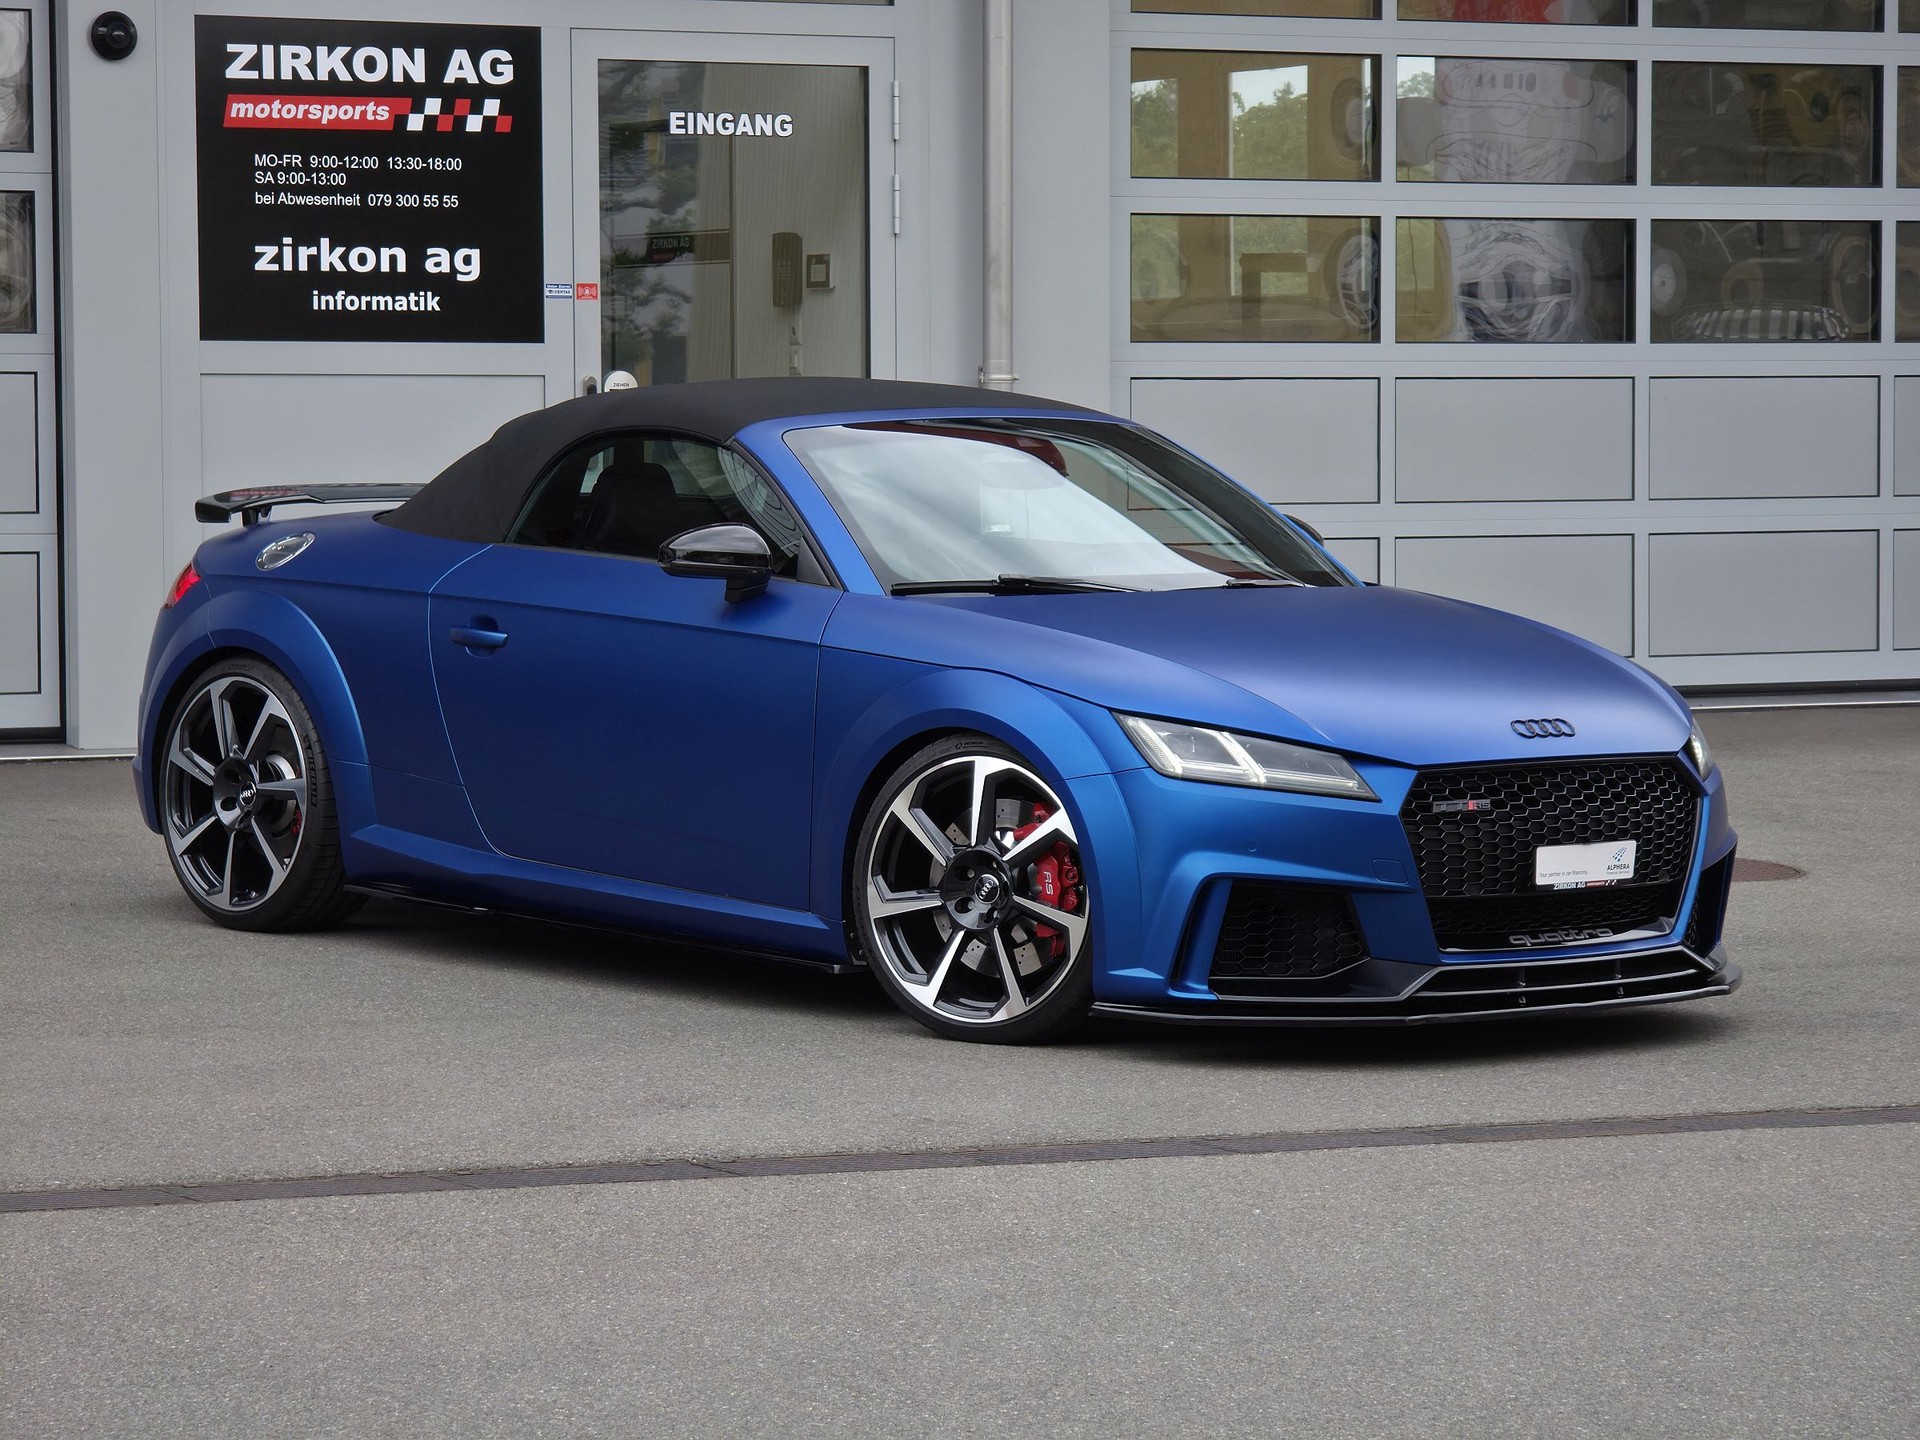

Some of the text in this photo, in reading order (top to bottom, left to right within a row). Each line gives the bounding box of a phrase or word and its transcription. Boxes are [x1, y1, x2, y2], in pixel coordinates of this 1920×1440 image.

[225, 43, 514, 84] ZIRKON AG
[230, 99, 390, 125] motorsports
[669, 111, 793, 137] EINGANG
[254, 154, 462, 171] MO-FR 9:00-12:00 13:30-18:00
[254, 171, 347, 186] SA 9:00-13:00
[255, 191, 459, 208] bei Abwesenheit 079 300 55 55
[254, 237, 481, 282] zirkon ag
[312, 290, 441, 312] informatik
[1606, 863, 1630, 871] ALPHERA
[1043, 871, 1054, 895] RS
[1553, 881, 1576, 890] ZIRKON
[1508, 927, 1614, 947] quattro
